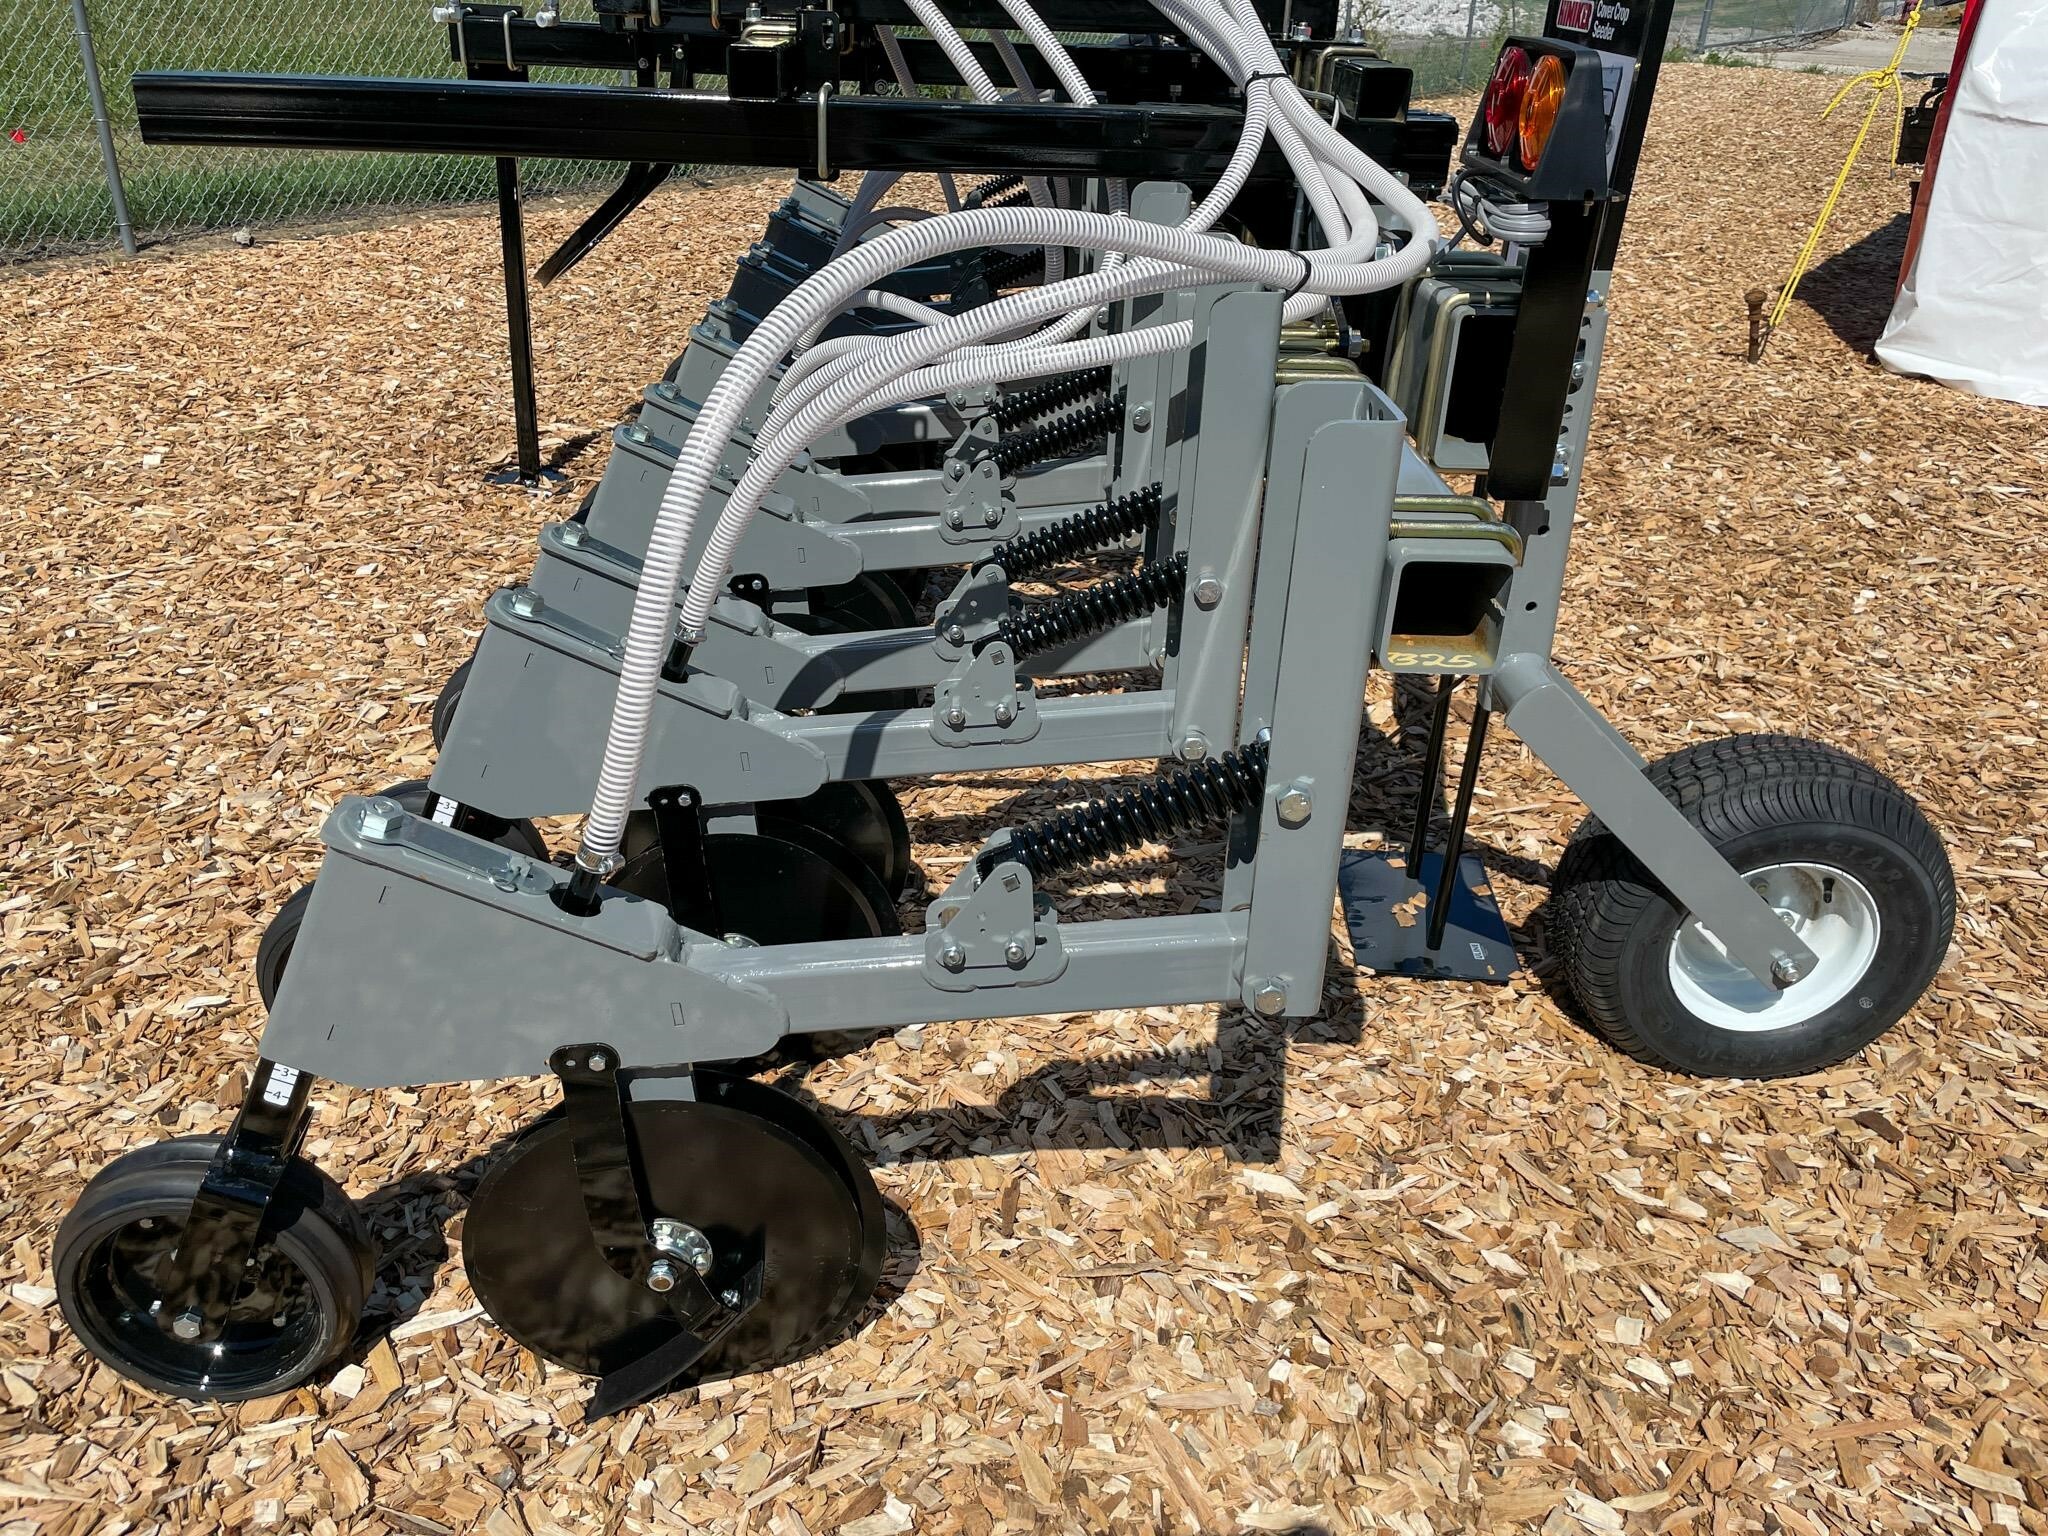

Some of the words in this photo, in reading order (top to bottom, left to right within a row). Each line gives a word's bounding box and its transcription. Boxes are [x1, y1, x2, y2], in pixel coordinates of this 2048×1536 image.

[1596, 0, 1614, 20] Cover
[1614, 2, 1630, 25] Crop
[1592, 20, 1616, 41] Seeder
[280, 1067, 290, 1077] 3
[272, 1090, 281, 1100] 4
